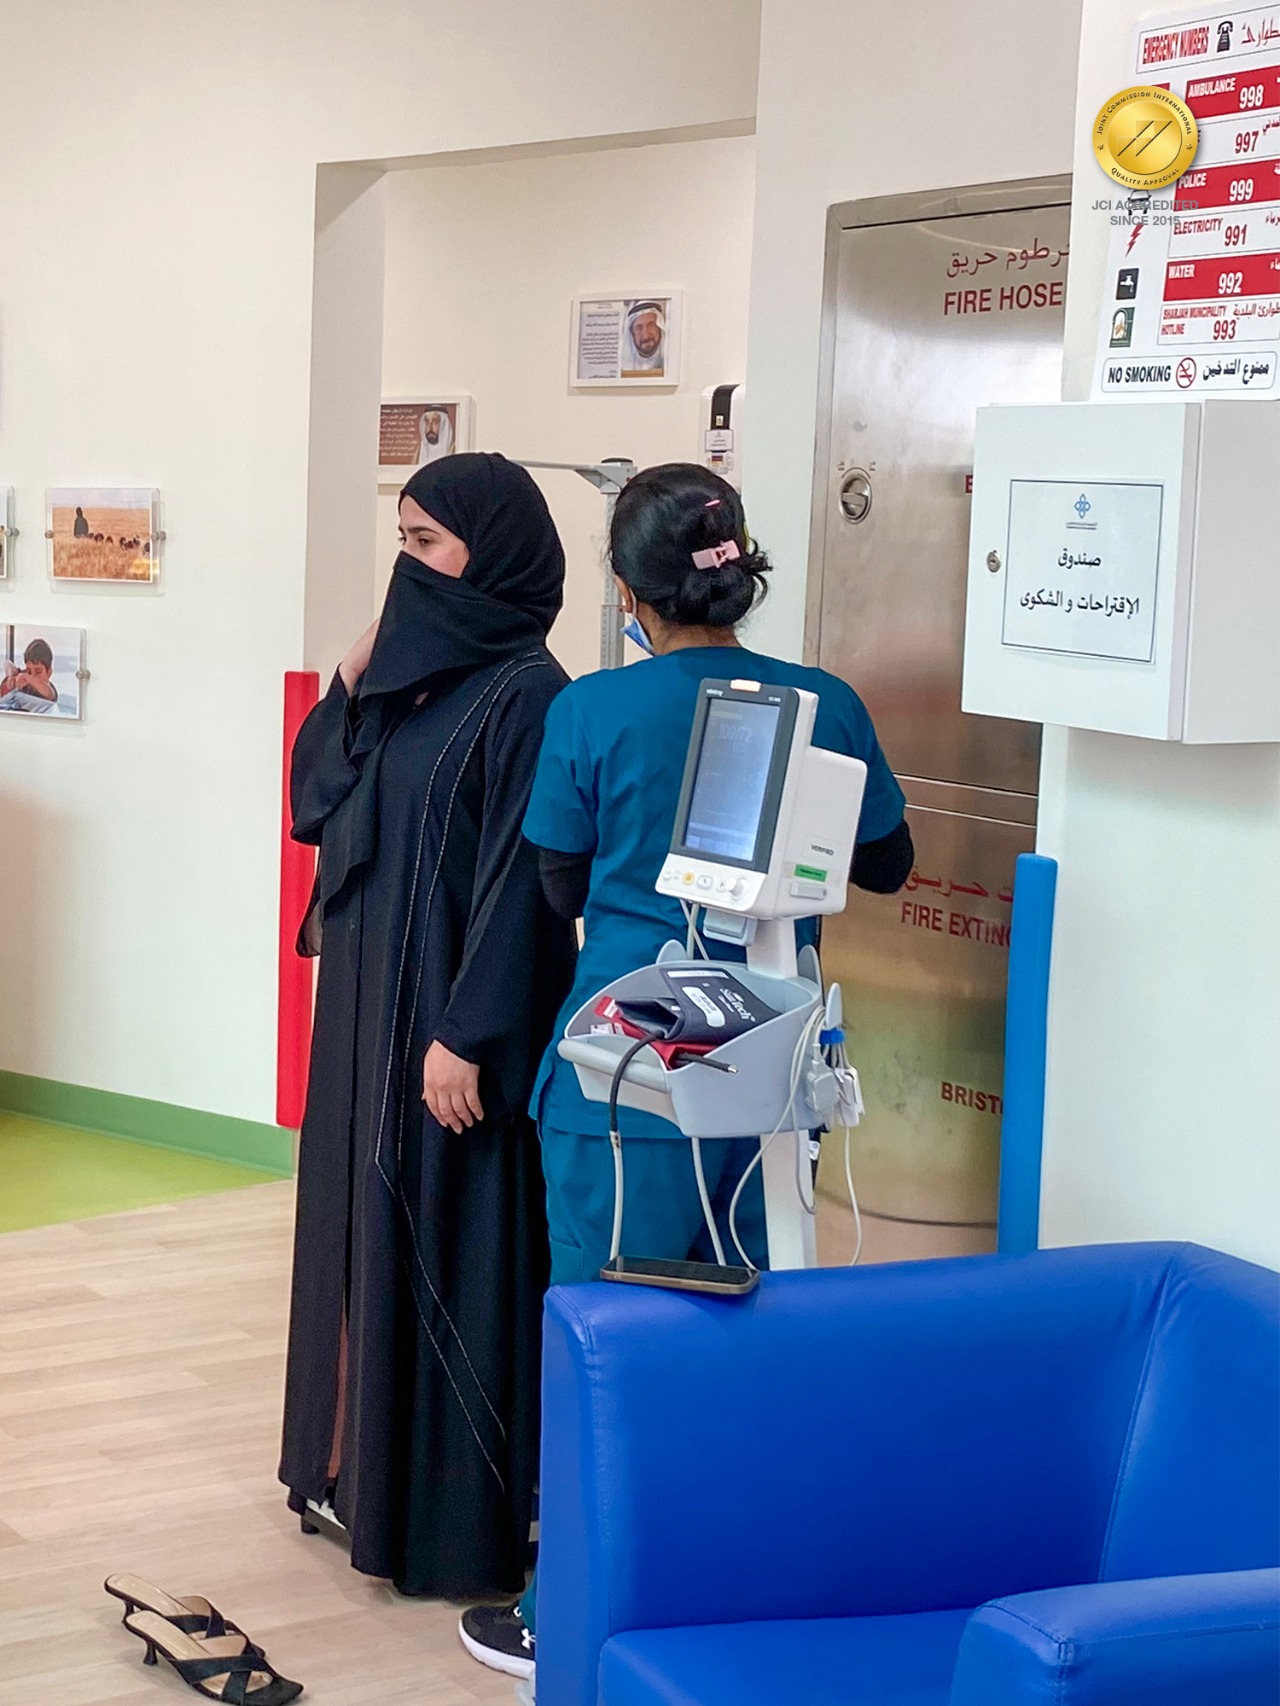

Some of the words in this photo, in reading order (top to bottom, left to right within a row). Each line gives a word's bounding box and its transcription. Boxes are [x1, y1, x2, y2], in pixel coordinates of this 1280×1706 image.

[1142, 32, 1179, 64] EMERGENCY
[1188, 78, 1236, 98] AMBULANCE
[1239, 84, 1264, 109] 998
[1235, 130, 1260, 154] 997
[1178, 173, 1207, 189] POLICE
[1229, 178, 1254, 202] 999
[1173, 218, 1223, 235] ELECTRICITY
[1224, 224, 1247, 247] 991
[947, 251, 998, 278] حريق
[1168, 264, 1195, 279] WATER
[1218, 271, 1243, 294] 992
[944, 288, 992, 315] FIRE
[999, 281, 1063, 310] HOSE
[1212, 319, 1237, 340] 993
[1108, 367, 1122, 383] NO
[1125, 366, 1172, 382] SMOKING
[1242, 361, 1269, 384] ممنوع
[1057, 547, 1101, 569] صندوق
[901, 901, 943, 932] FIRE
[949, 911, 1011, 948] EXTIN
[941, 1081, 1004, 1115] BRIST
